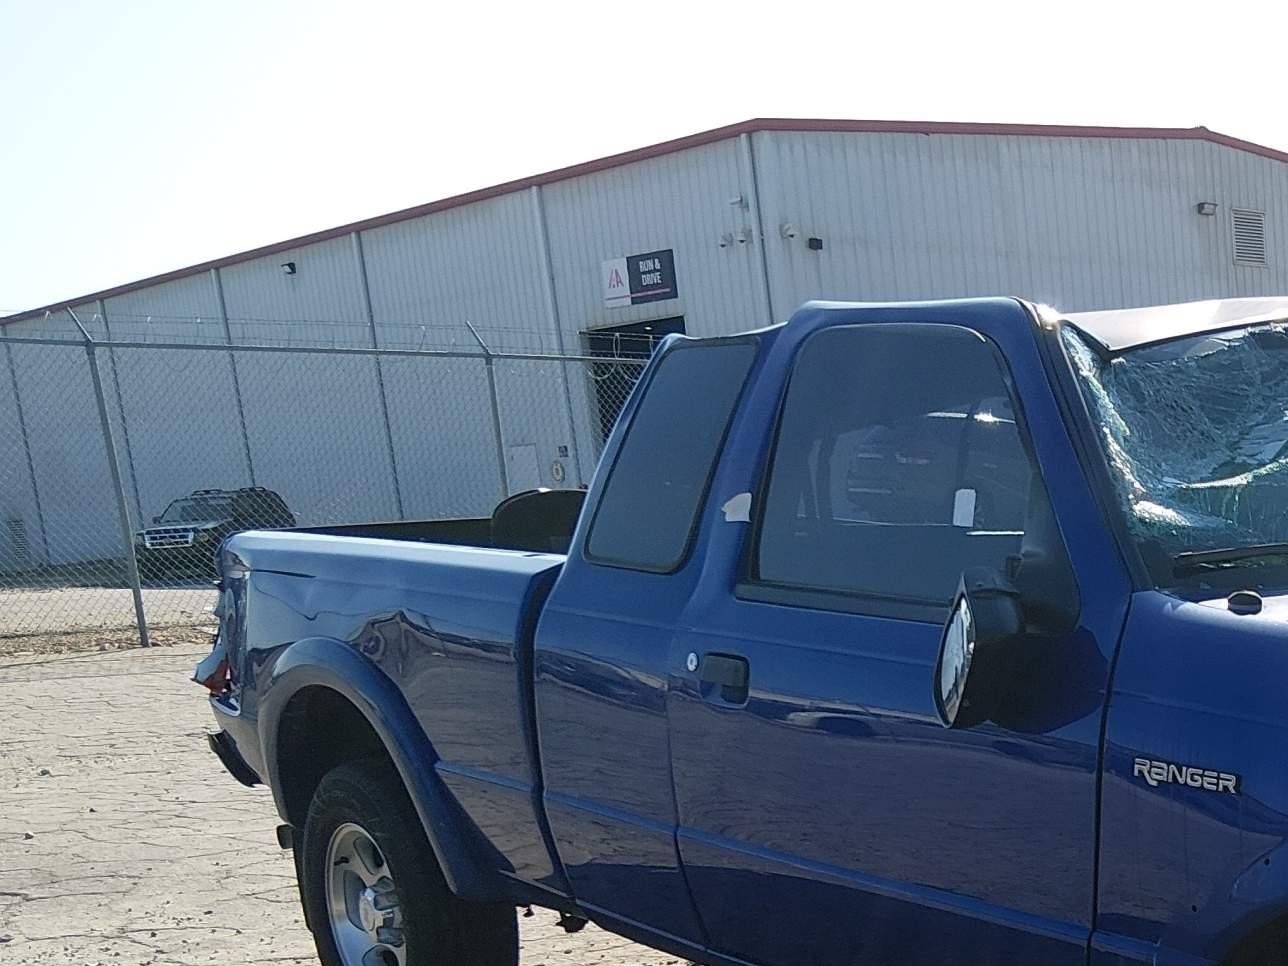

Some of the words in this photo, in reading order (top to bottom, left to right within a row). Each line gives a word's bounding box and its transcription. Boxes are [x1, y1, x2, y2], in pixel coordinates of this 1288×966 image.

[639, 259, 654, 272] RUN
[654, 258, 661, 270] &
[641, 272, 662, 286] DRIVE
[1133, 757, 1237, 793] RANGER
